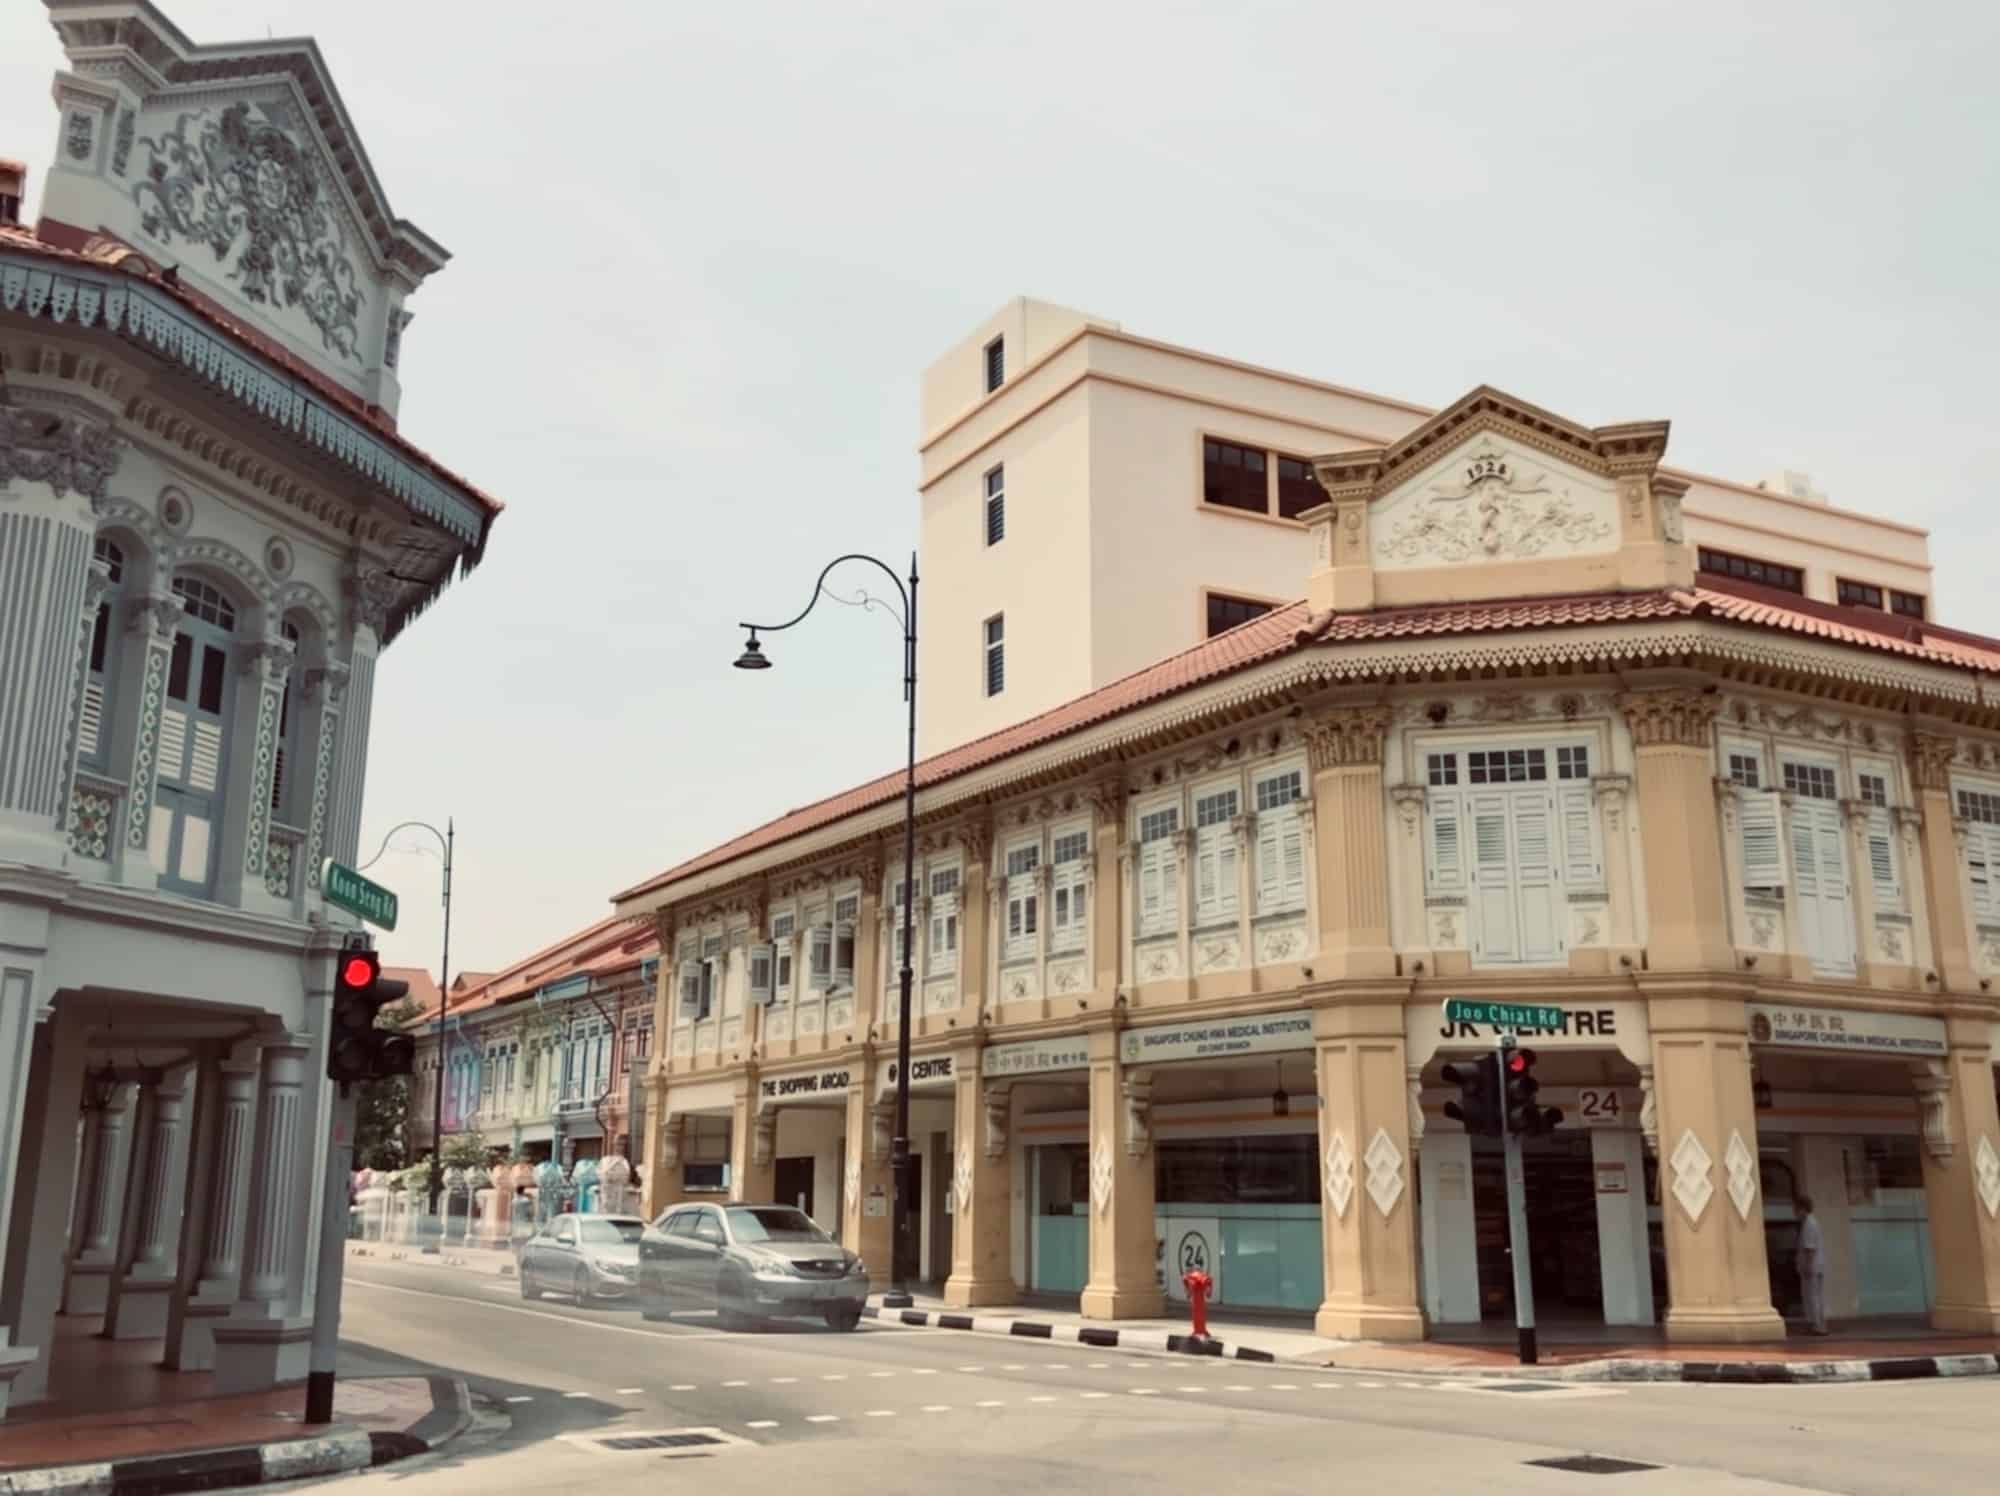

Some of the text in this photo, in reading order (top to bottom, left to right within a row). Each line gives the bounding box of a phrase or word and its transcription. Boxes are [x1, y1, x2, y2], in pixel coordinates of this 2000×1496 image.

[1455, 1003, 1557, 1025] Joo Chiat Rd
[1144, 1032, 1181, 1047] SINGAPORE
[1227, 1025, 1260, 1038] MEDICAL
[1262, 1019, 1311, 1034] INSTITUTION
[912, 1058, 952, 1080] CENTRE
[762, 1080, 776, 1096] THE
[779, 1074, 817, 1094] SHOPPING
[1582, 1091, 1619, 1116] 24
[1185, 1245, 1204, 1267] 24
